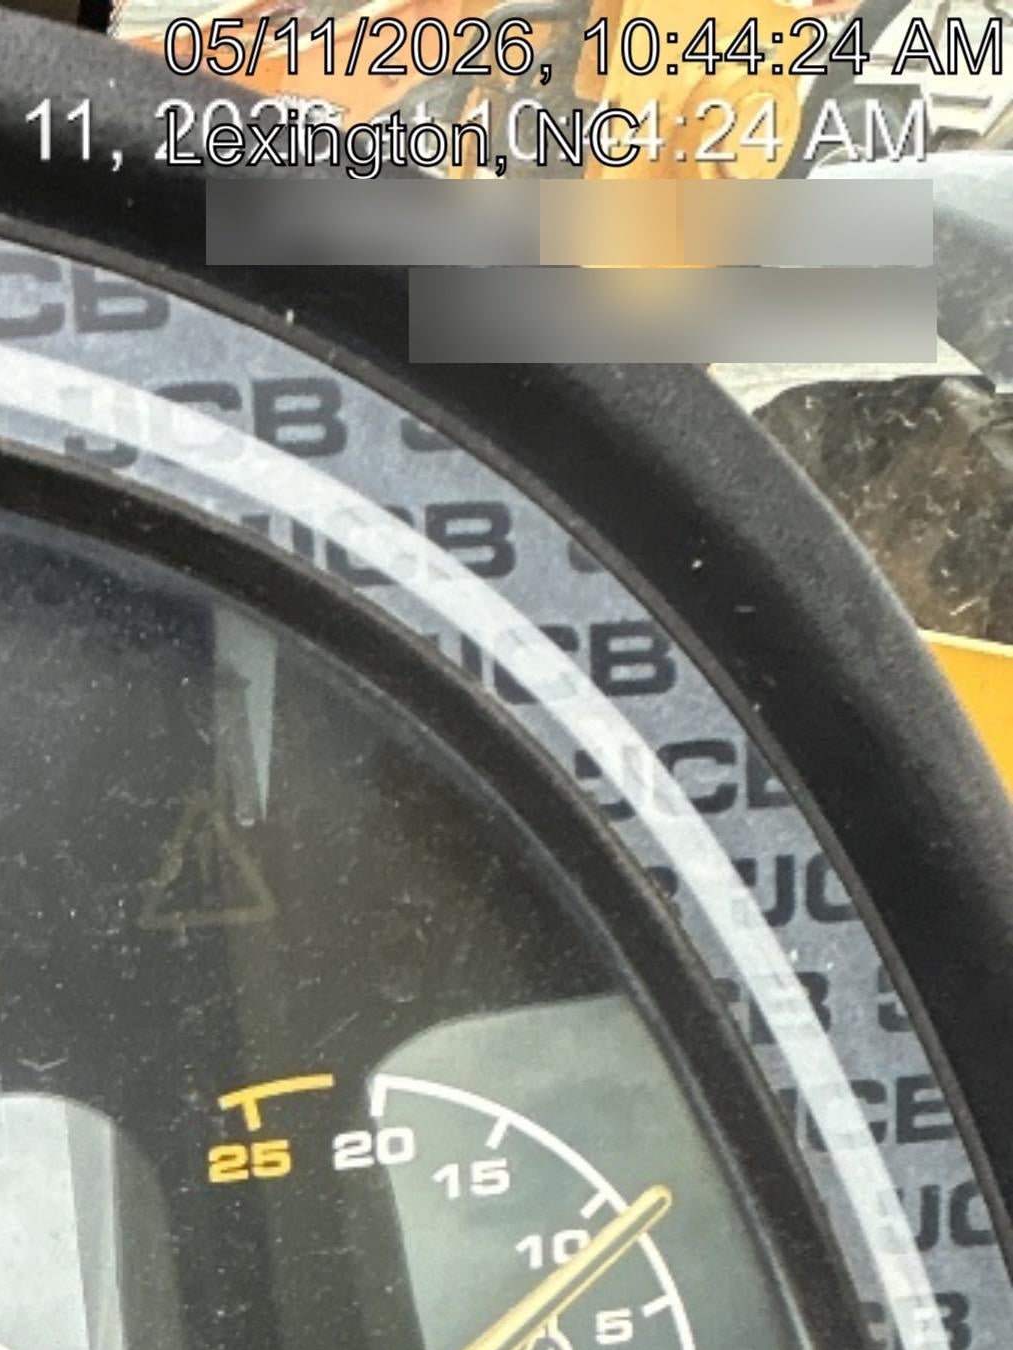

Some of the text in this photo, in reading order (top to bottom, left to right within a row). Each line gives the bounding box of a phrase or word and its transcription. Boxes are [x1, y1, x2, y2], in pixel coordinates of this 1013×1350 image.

[207, 1139, 292, 1184] 25
[332, 1127, 416, 1171] 20
[433, 1159, 511, 1199] 15
[515, 1228, 590, 1271] 10
[595, 1309, 634, 1344] 5
